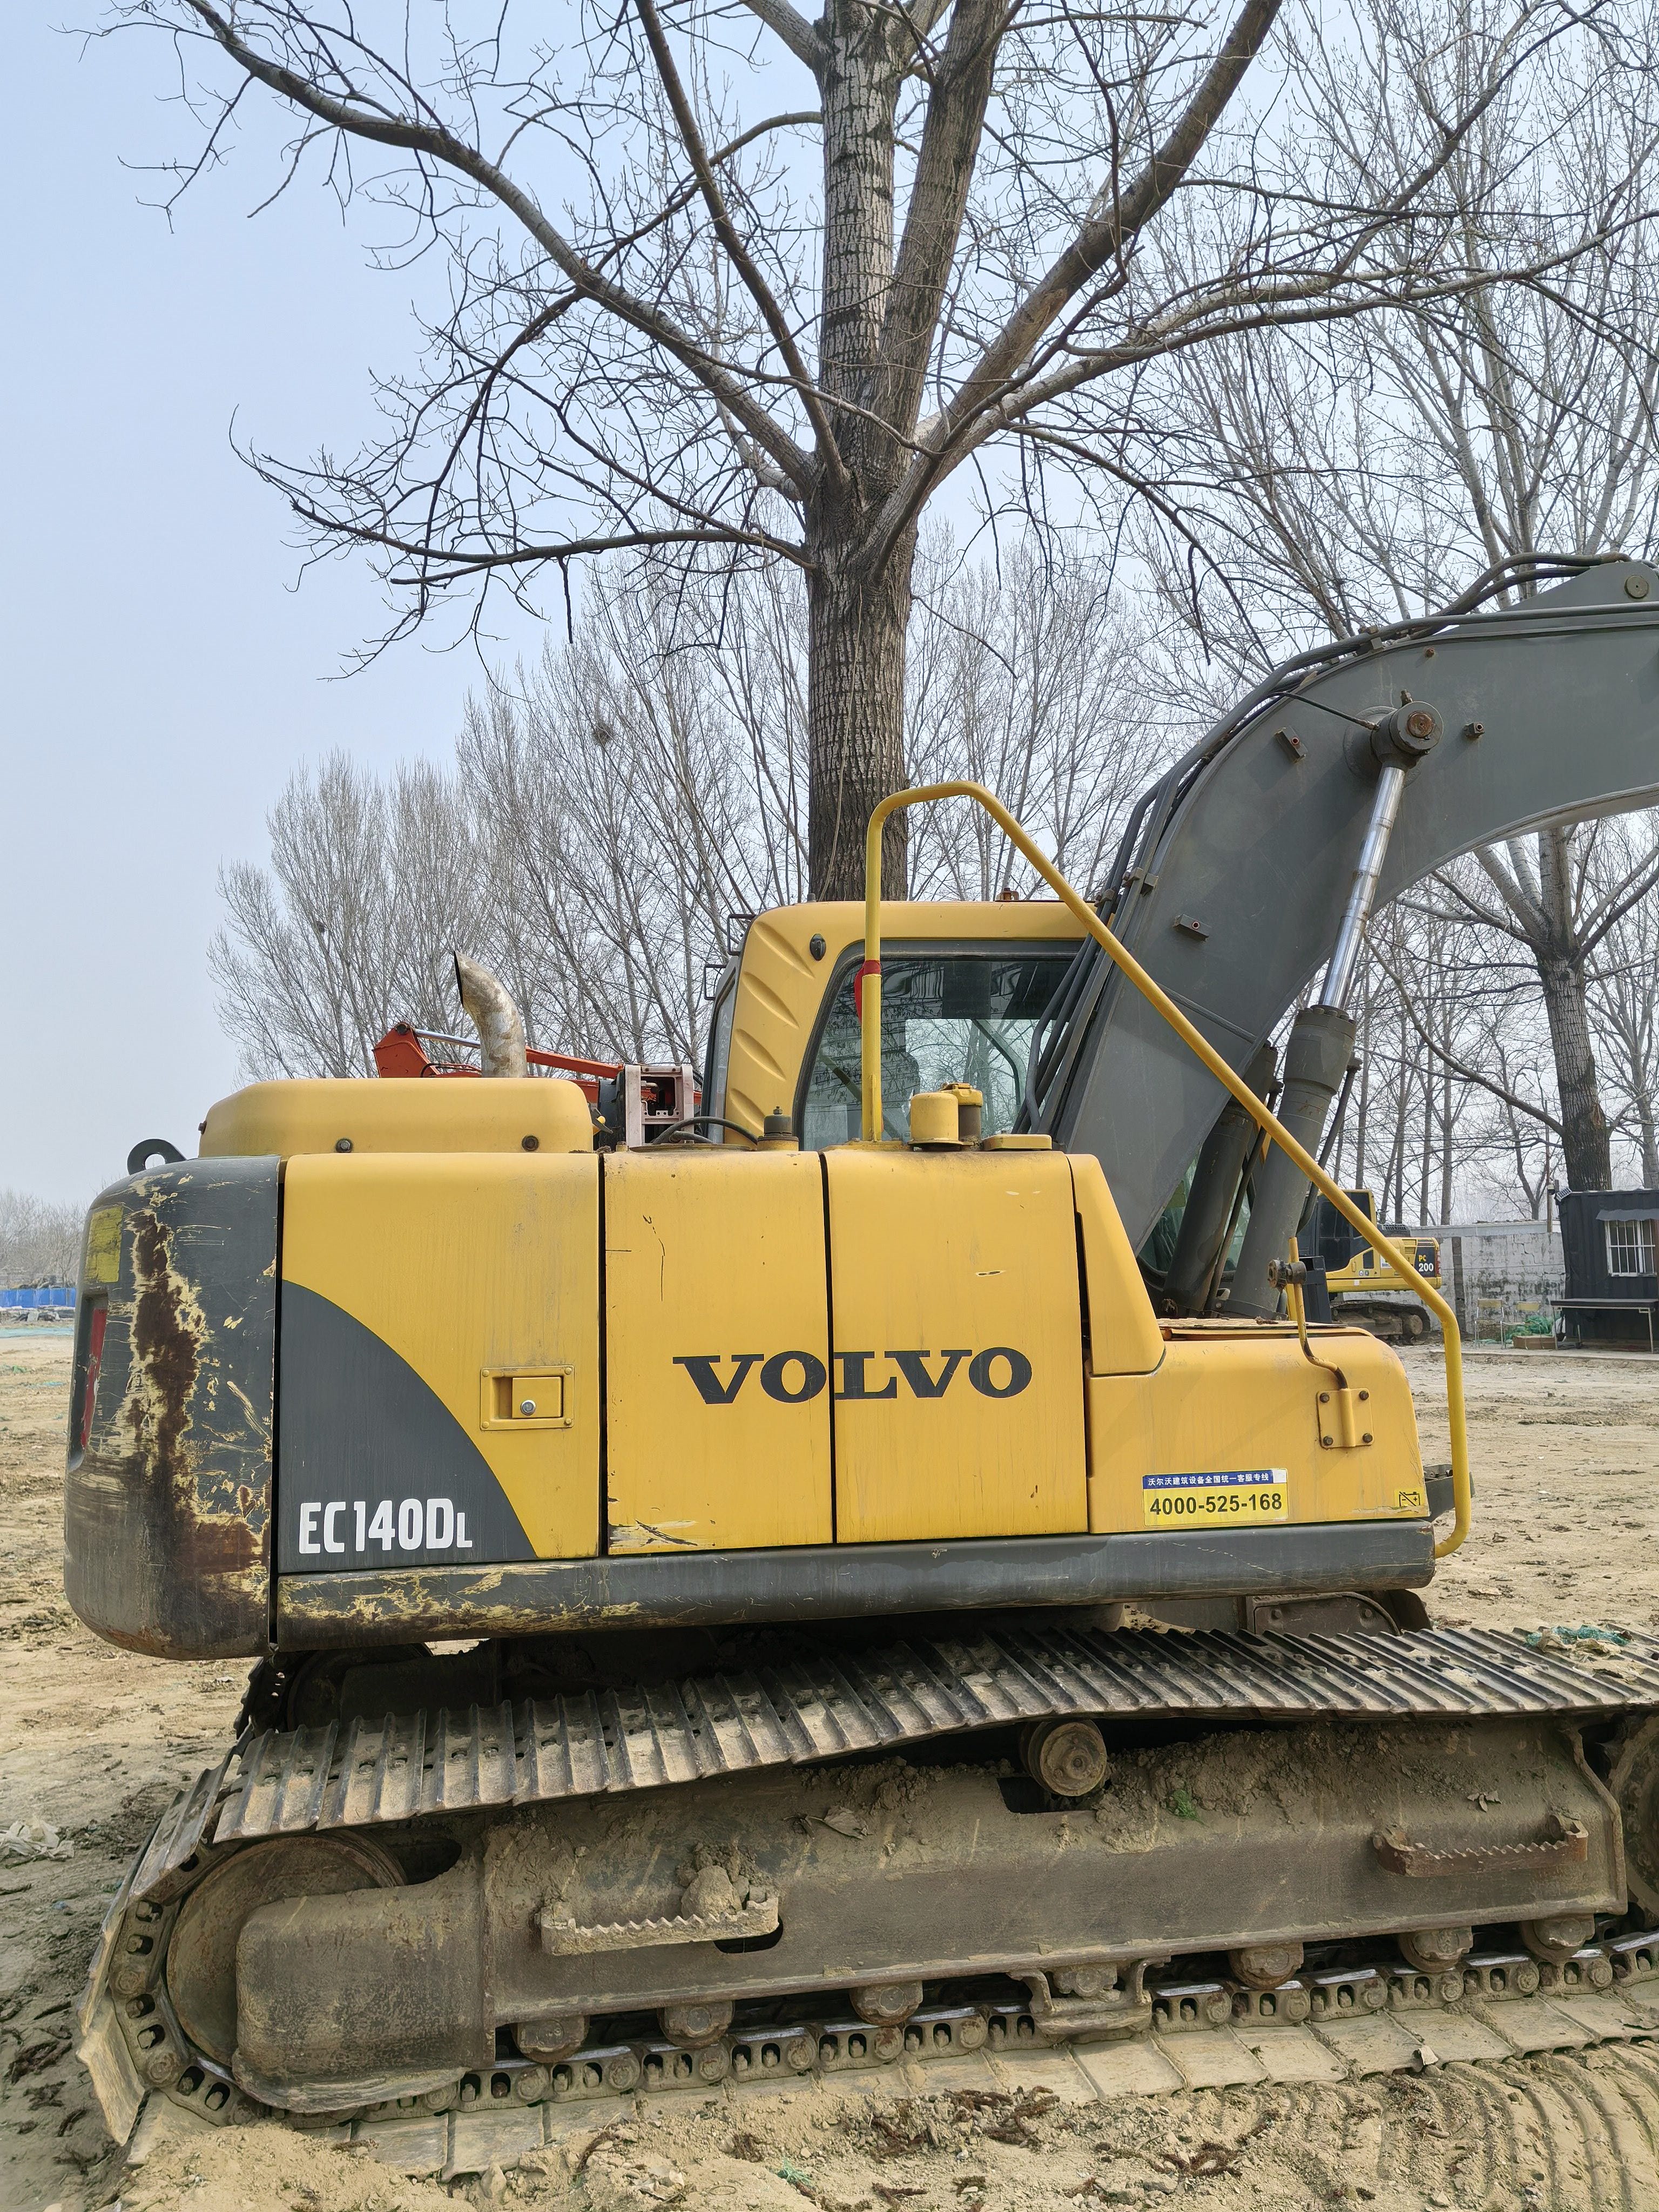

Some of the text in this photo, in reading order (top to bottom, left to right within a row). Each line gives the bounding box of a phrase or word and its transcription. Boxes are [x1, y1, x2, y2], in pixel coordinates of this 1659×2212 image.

[1418, 1263, 1434, 1272] 200
[673, 1347, 1032, 1404] VOLVO
[1148, 1473, 1269, 1486] 沃尔沃建筑设备全国统一客服专线
[1150, 1493, 1282, 1515] 4000-525-168
